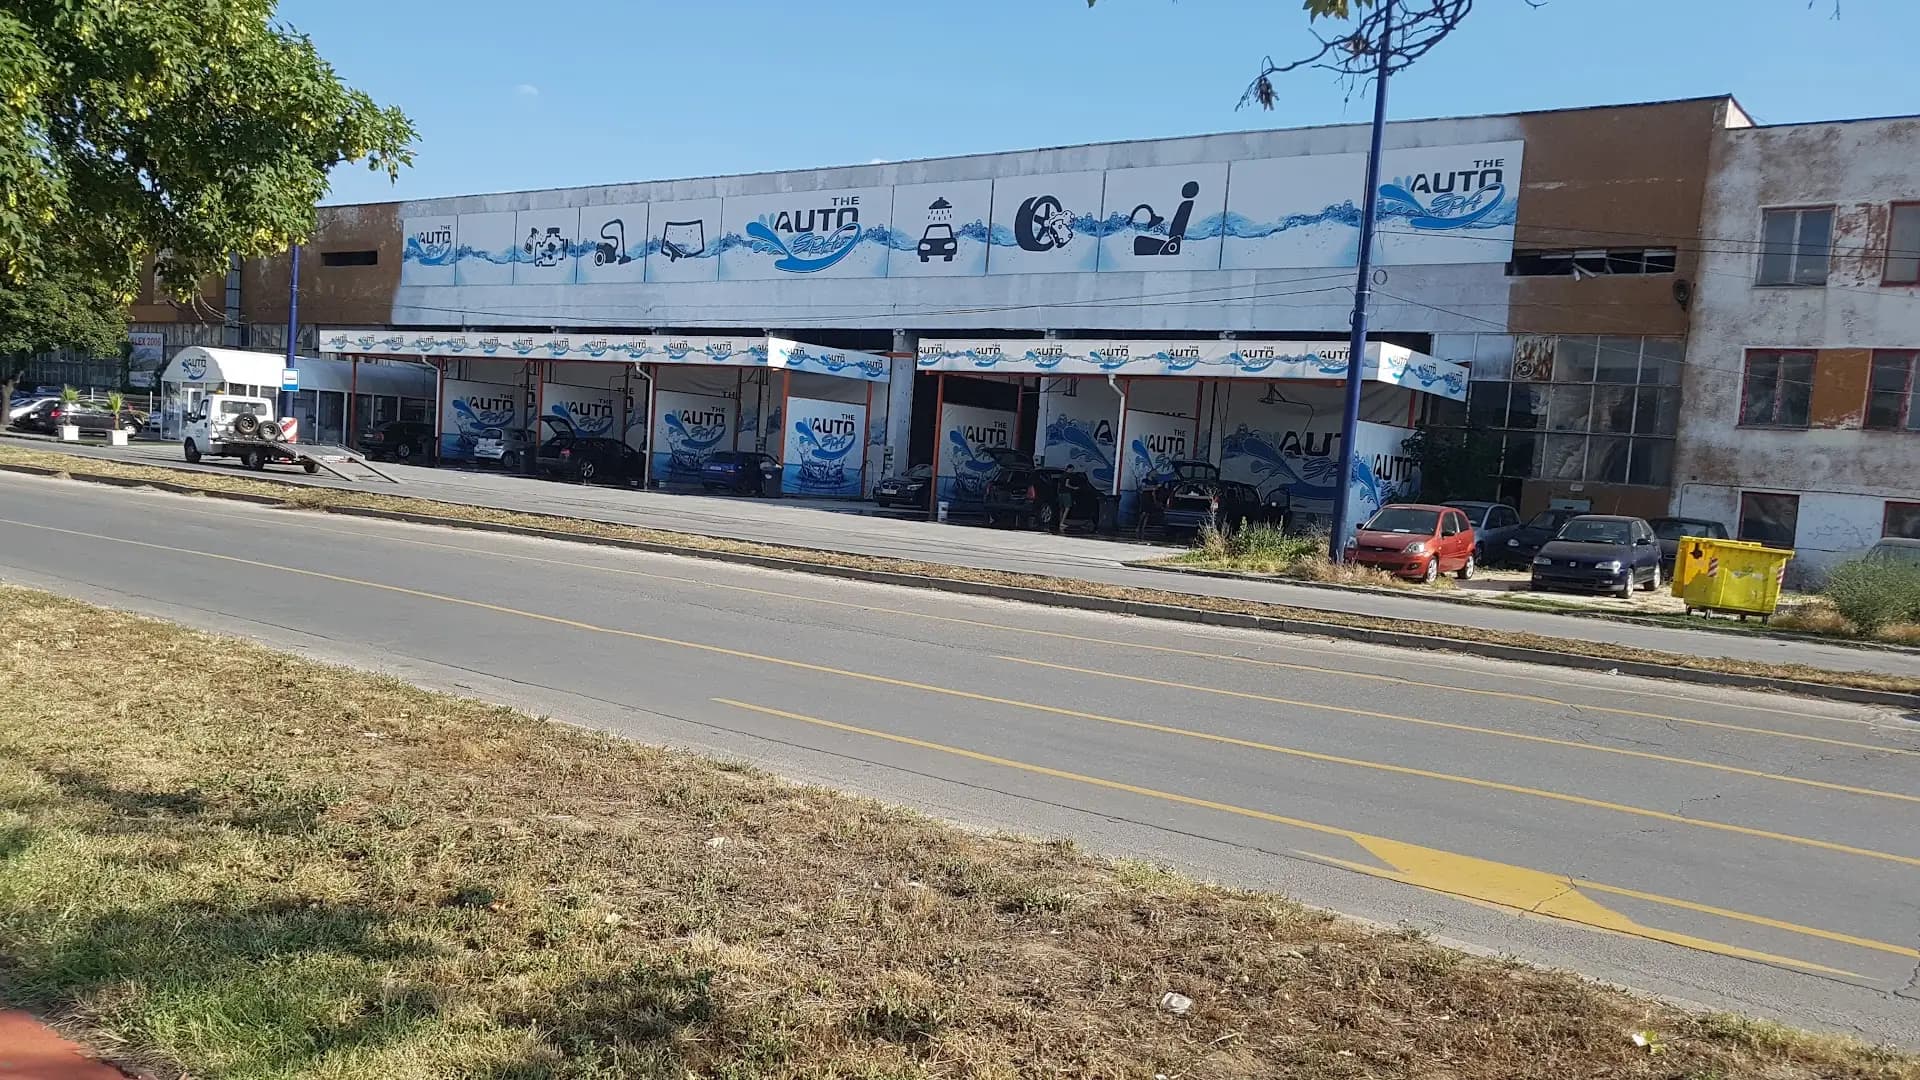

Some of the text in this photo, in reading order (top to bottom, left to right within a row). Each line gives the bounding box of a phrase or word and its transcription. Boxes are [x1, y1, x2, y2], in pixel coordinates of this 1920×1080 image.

[1473, 158, 1505, 169] THE
[1410, 168, 1504, 194] AUTO
[831, 196, 860, 207] THE
[774, 207, 859, 234] AUTO
[418, 230, 451, 245] AUTO
[918, 347, 942, 355] AUTO
[975, 347, 1001, 355] AUTO
[1036, 347, 1063, 356] AUTO
[1099, 348, 1129, 357] AUTO
[1168, 349, 1199, 357] AUTO
[1241, 349, 1274, 359] AUTO
[189, 358, 207, 368] AUTO
[470, 396, 514, 412] AUTO
[569, 401, 612, 418] AUTO
[681, 409, 725, 427] AUTO
[841, 413, 856, 421] THE
[812, 417, 855, 436] AUTO
[994, 421, 1007, 429] THE
[965, 425, 1007, 444] AUTO
[1174, 429, 1186, 437] THE
[1146, 434, 1185, 455] AUTO
[1279, 430, 1342, 457] AU
[1373, 453, 1412, 483] AUTO
